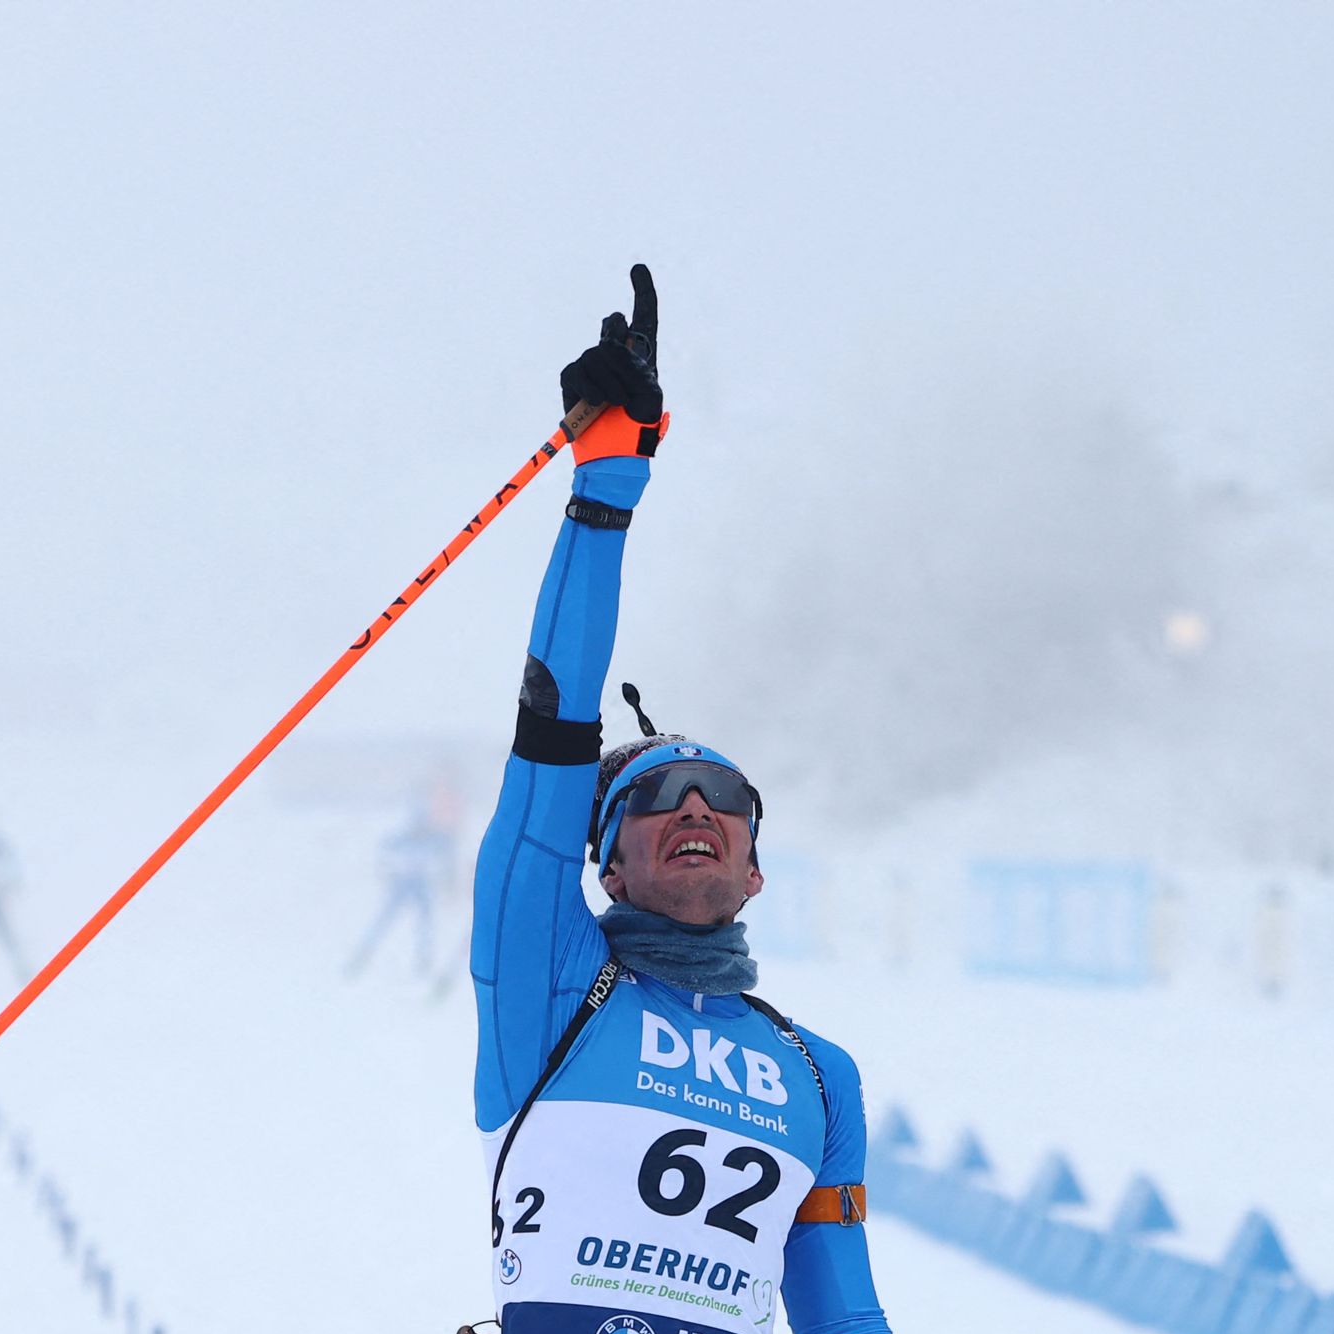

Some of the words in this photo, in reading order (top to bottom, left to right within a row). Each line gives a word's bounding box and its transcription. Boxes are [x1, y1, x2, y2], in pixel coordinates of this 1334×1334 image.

[587, 962, 618, 1010] FIOCCHI
[640, 1009, 788, 1106] DKB
[636, 1071, 676, 1097] Das
[683, 1084, 732, 1115] kann
[738, 1102, 789, 1136] Bank
[638, 1129, 781, 1244] 62
[570, 1273, 620, 1290] Grünes
[623, 1279, 656, 1296] Herz
[658, 1285, 743, 1317] Deutschlands
[576, 1236, 750, 1296] OBERHOF
